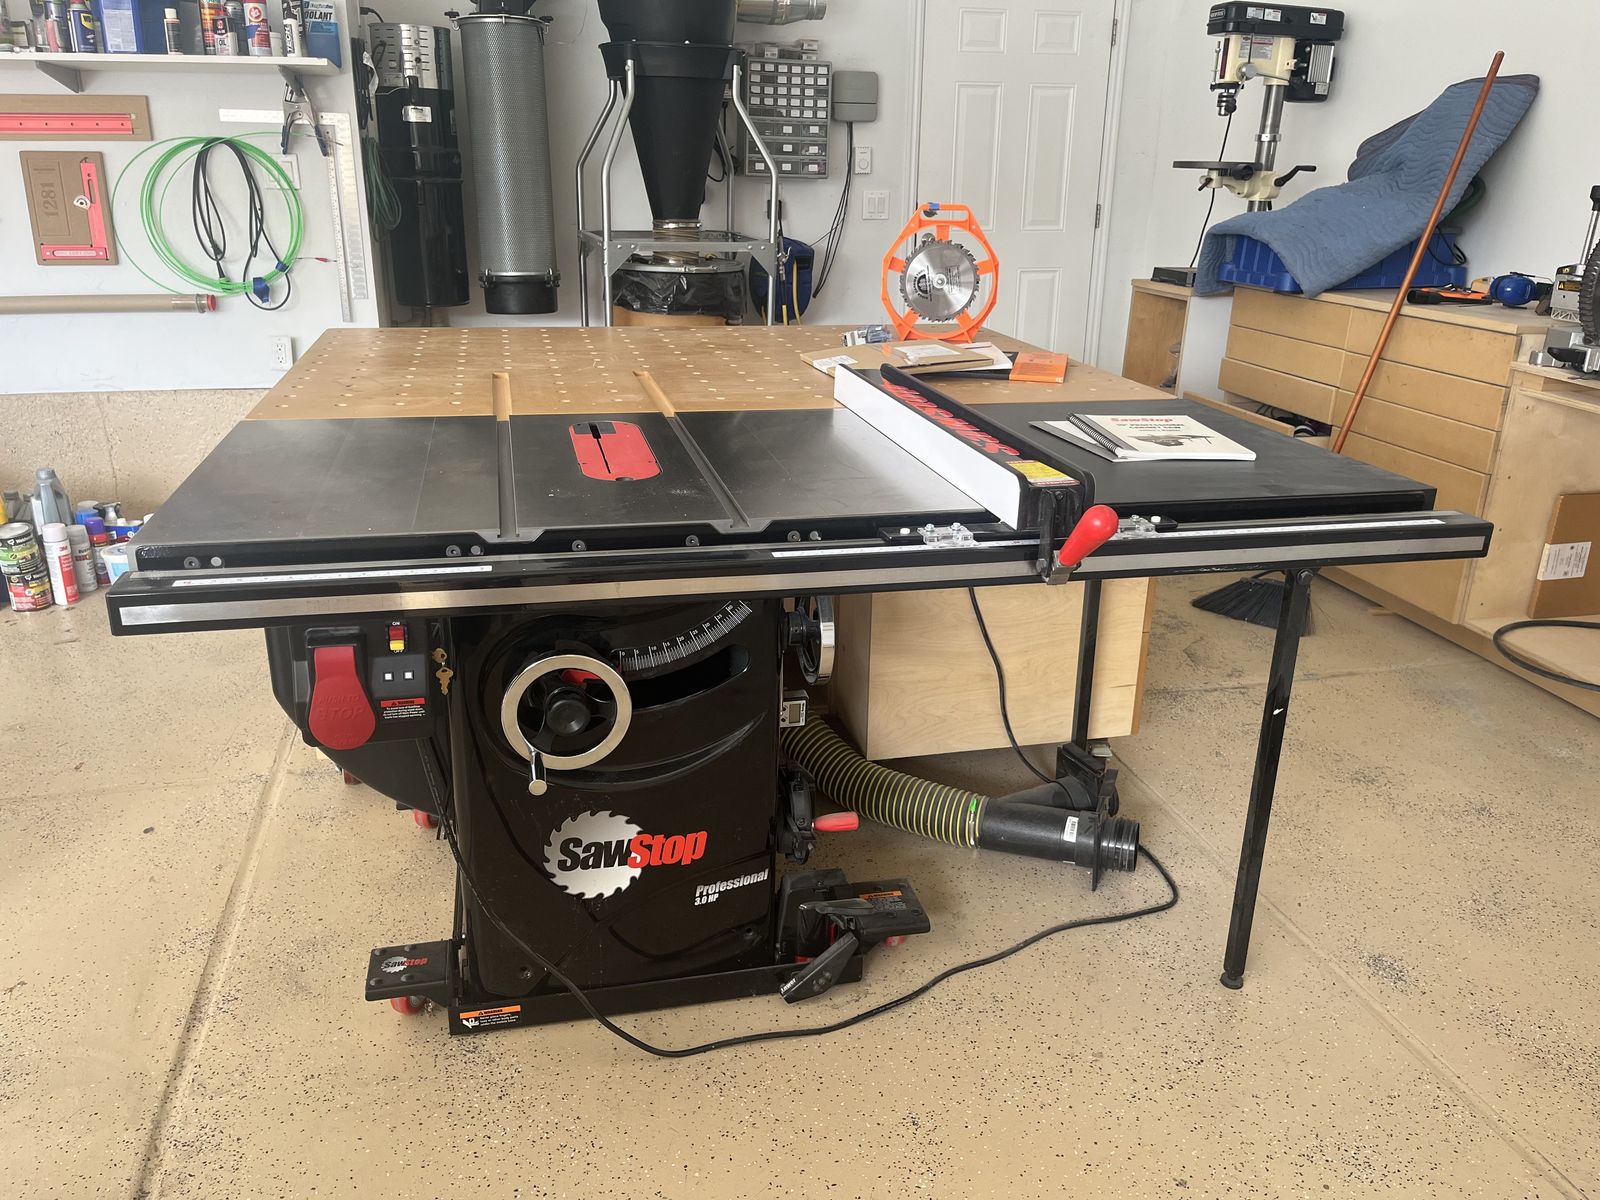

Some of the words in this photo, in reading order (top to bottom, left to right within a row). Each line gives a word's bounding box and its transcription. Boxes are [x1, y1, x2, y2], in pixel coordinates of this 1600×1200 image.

[304, 11, 333, 21] OOLANT
[40, 183, 59, 217] 1281
[316, 706, 366, 721] STOP
[557, 830, 708, 872] SawStop
[695, 868, 769, 897] Professional
[694, 896, 707, 906] 3.0
[708, 893, 719, 903] HP
[383, 957, 428, 969] SawStop
